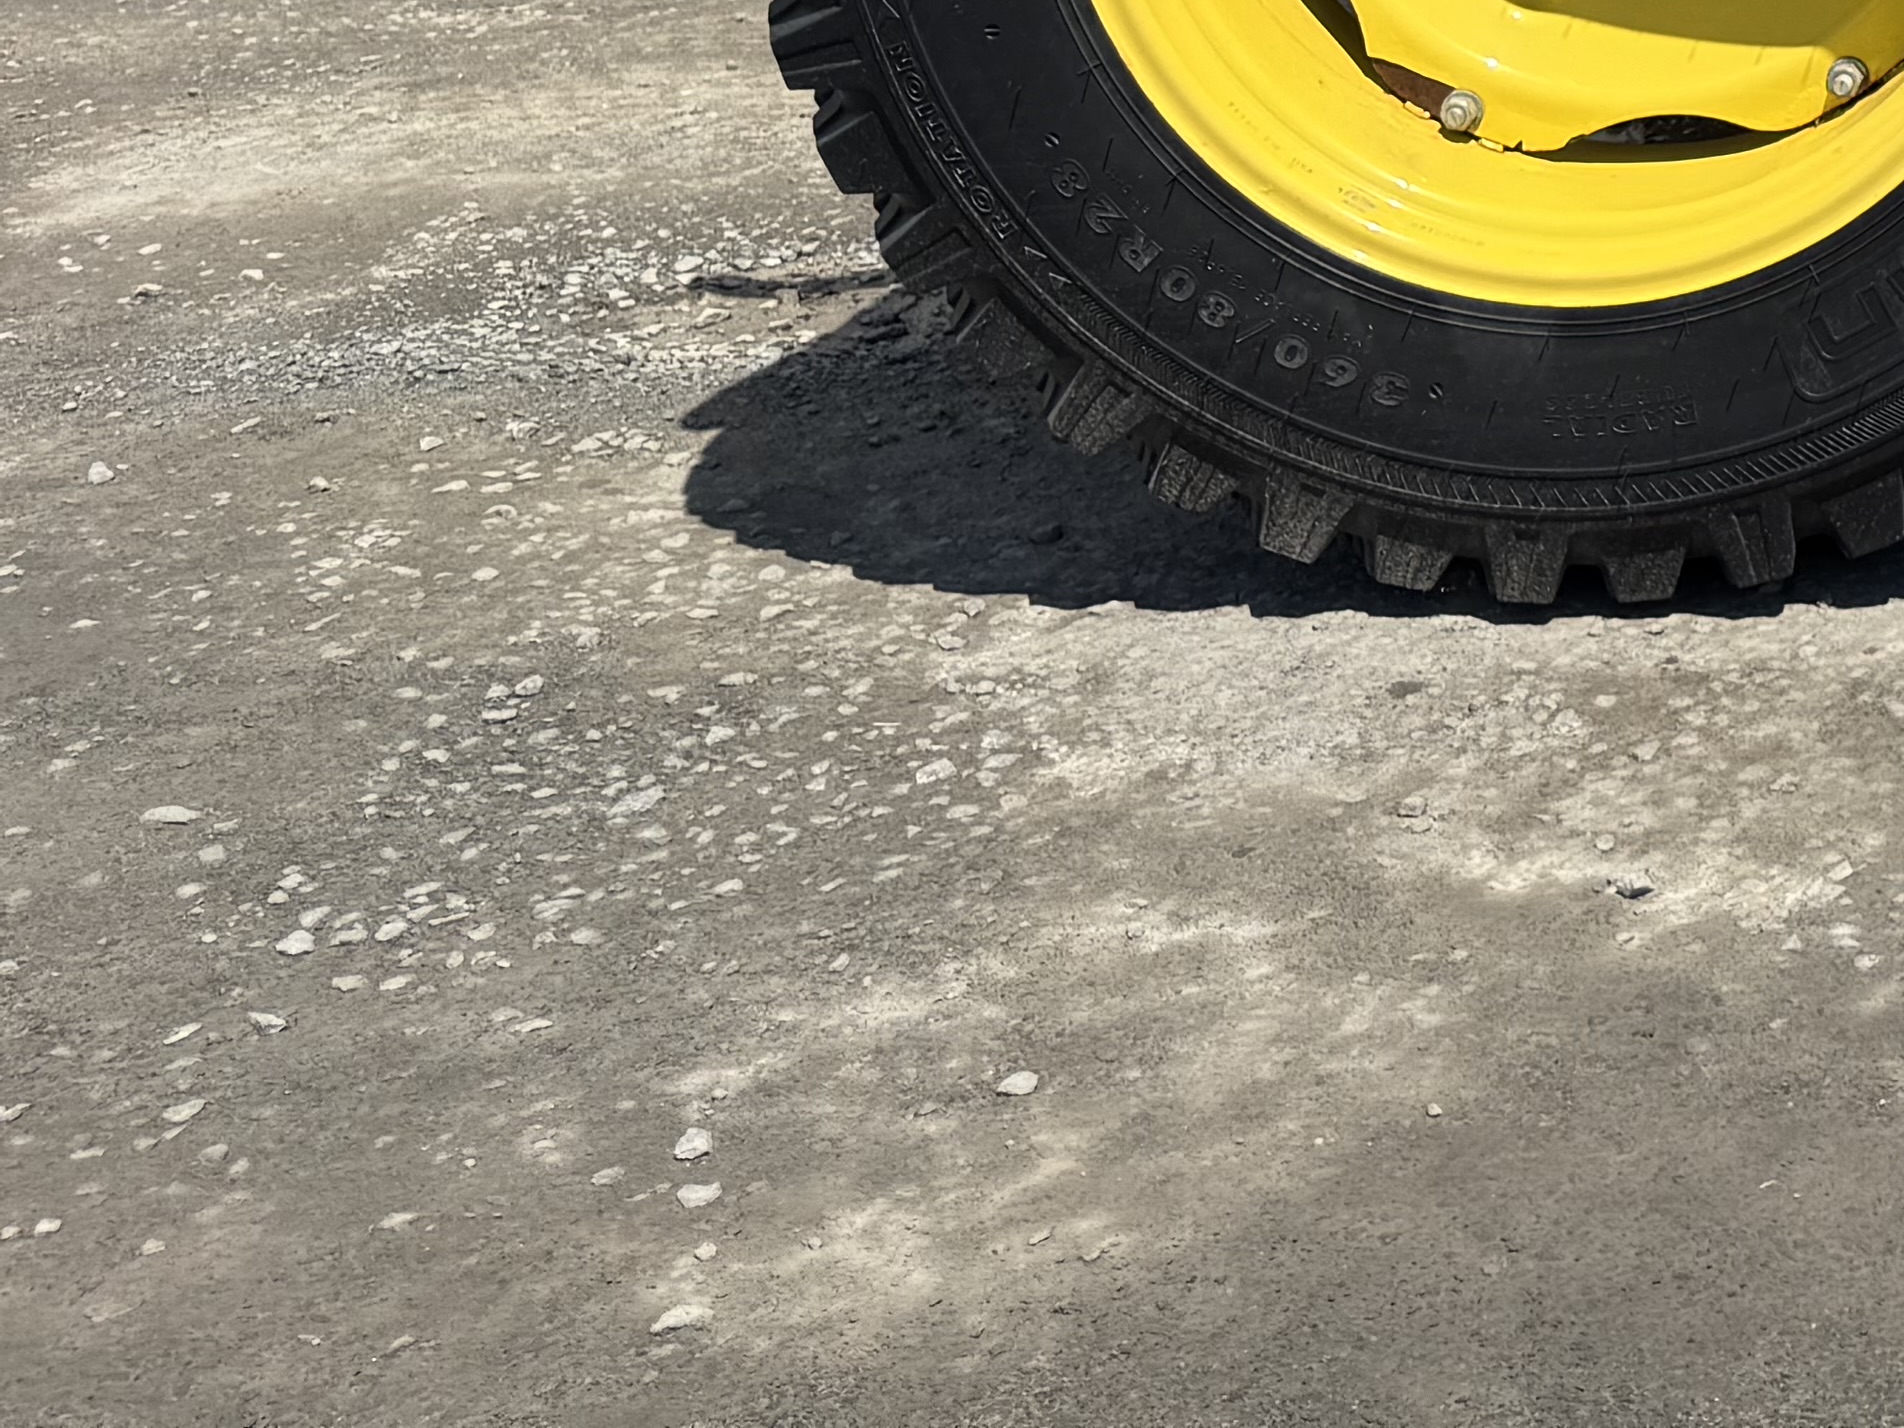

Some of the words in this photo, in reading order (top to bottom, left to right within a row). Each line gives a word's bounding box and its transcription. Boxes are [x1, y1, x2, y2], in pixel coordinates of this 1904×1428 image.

[888, 40, 1019, 241] ROTATION
[1049, 157, 1412, 408] 360/80R28
[1542, 400, 1698, 437] RADIAL
